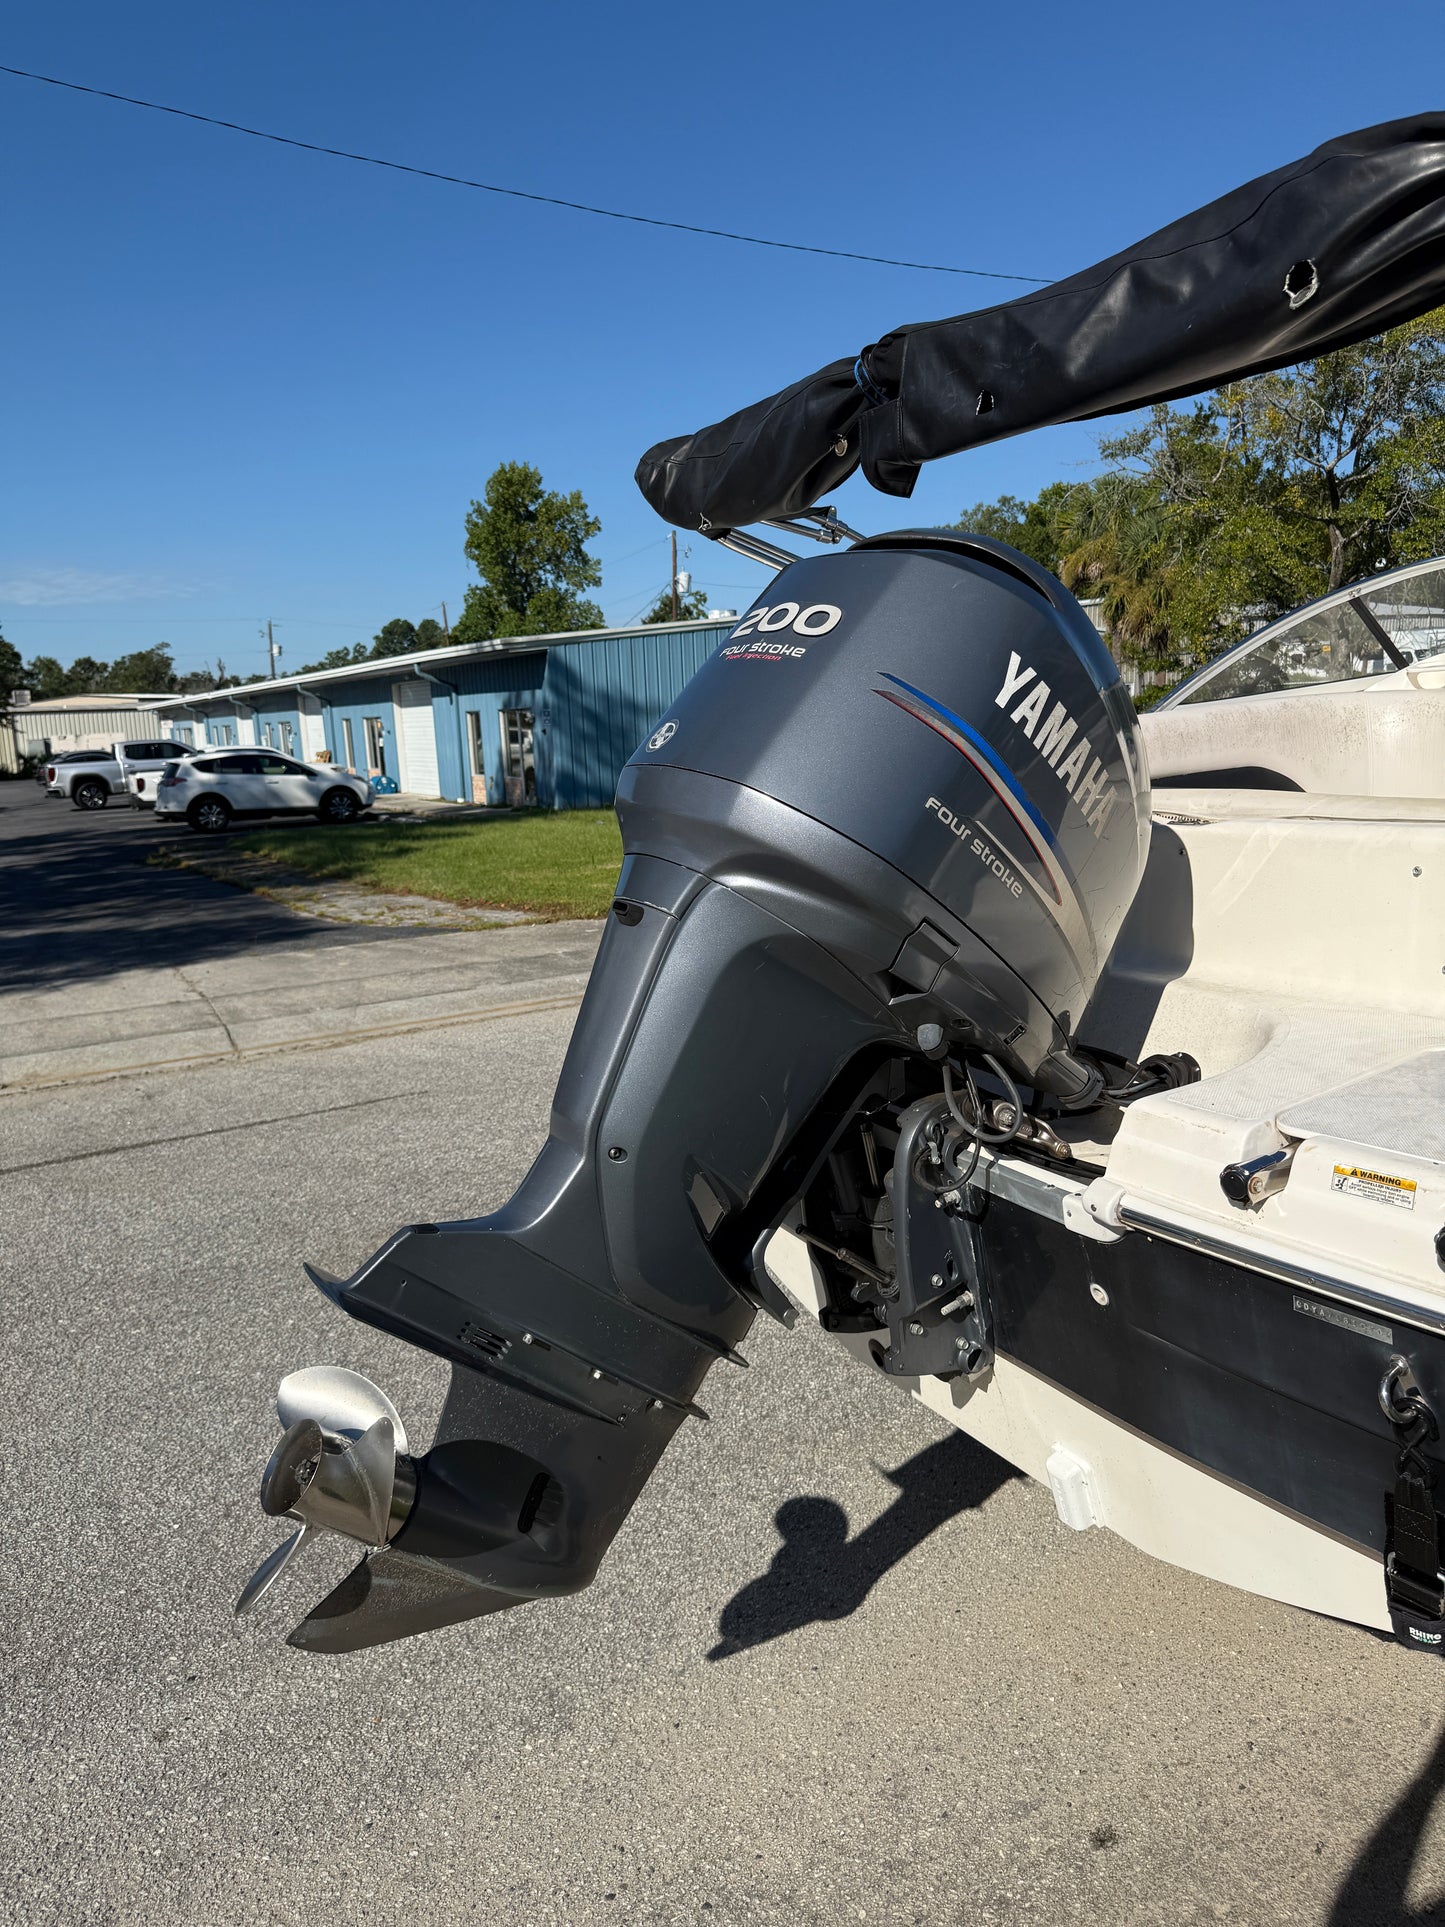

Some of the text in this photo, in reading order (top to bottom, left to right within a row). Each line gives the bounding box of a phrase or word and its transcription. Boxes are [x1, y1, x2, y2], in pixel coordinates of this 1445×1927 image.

[730, 601, 842, 639] 200
[994, 650, 1119, 840] YAMAHA
[1360, 1170, 1402, 1187] WARNING
[1409, 1627, 1442, 1640] RHINO
